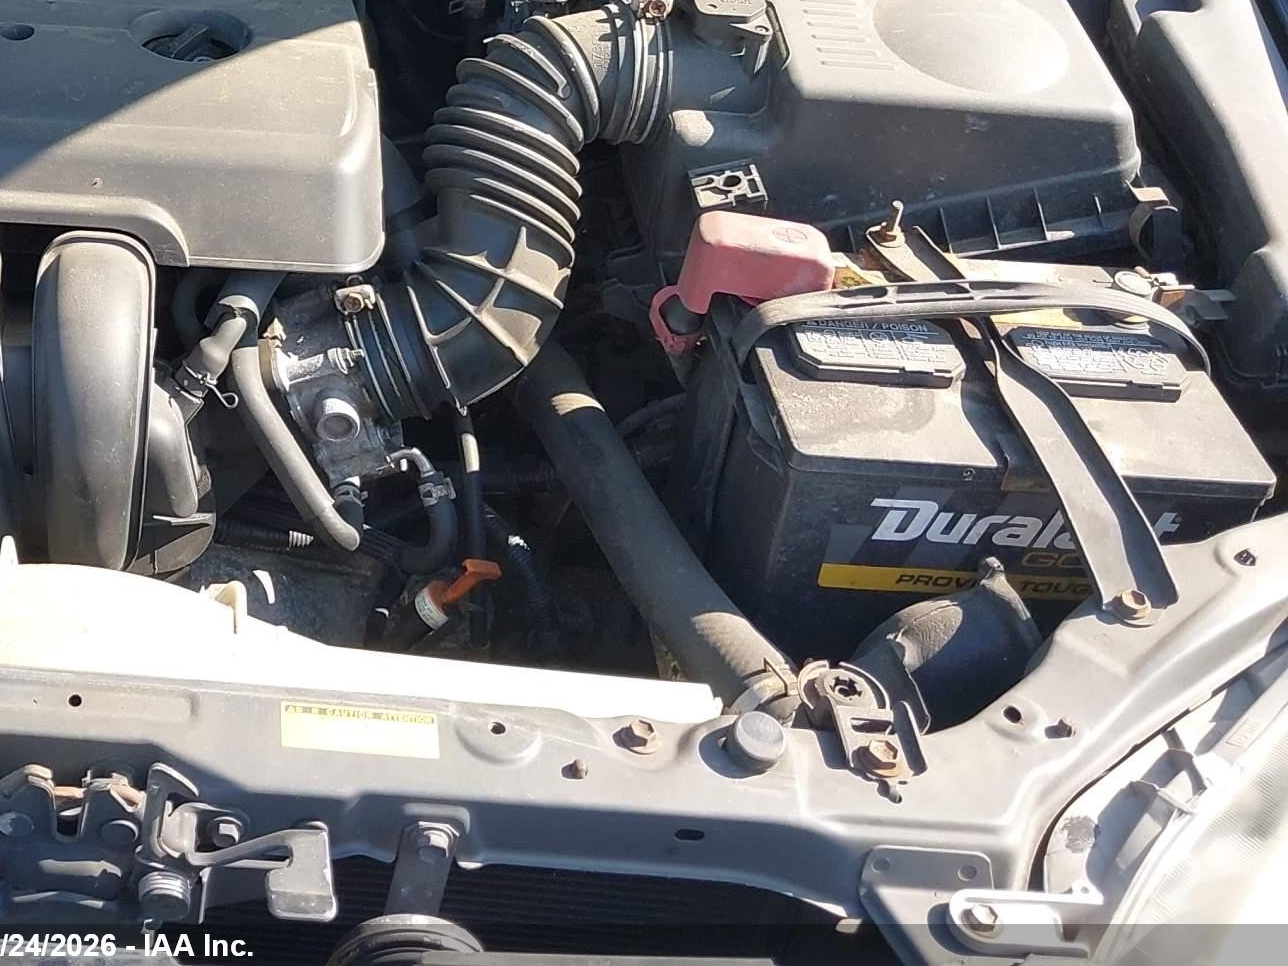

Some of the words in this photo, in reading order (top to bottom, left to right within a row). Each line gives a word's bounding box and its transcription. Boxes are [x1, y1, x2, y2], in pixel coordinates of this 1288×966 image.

[882, 323, 929, 332] POISON
[870, 497, 1181, 549] Duralt
[1020, 580, 1093, 595] TOUG
